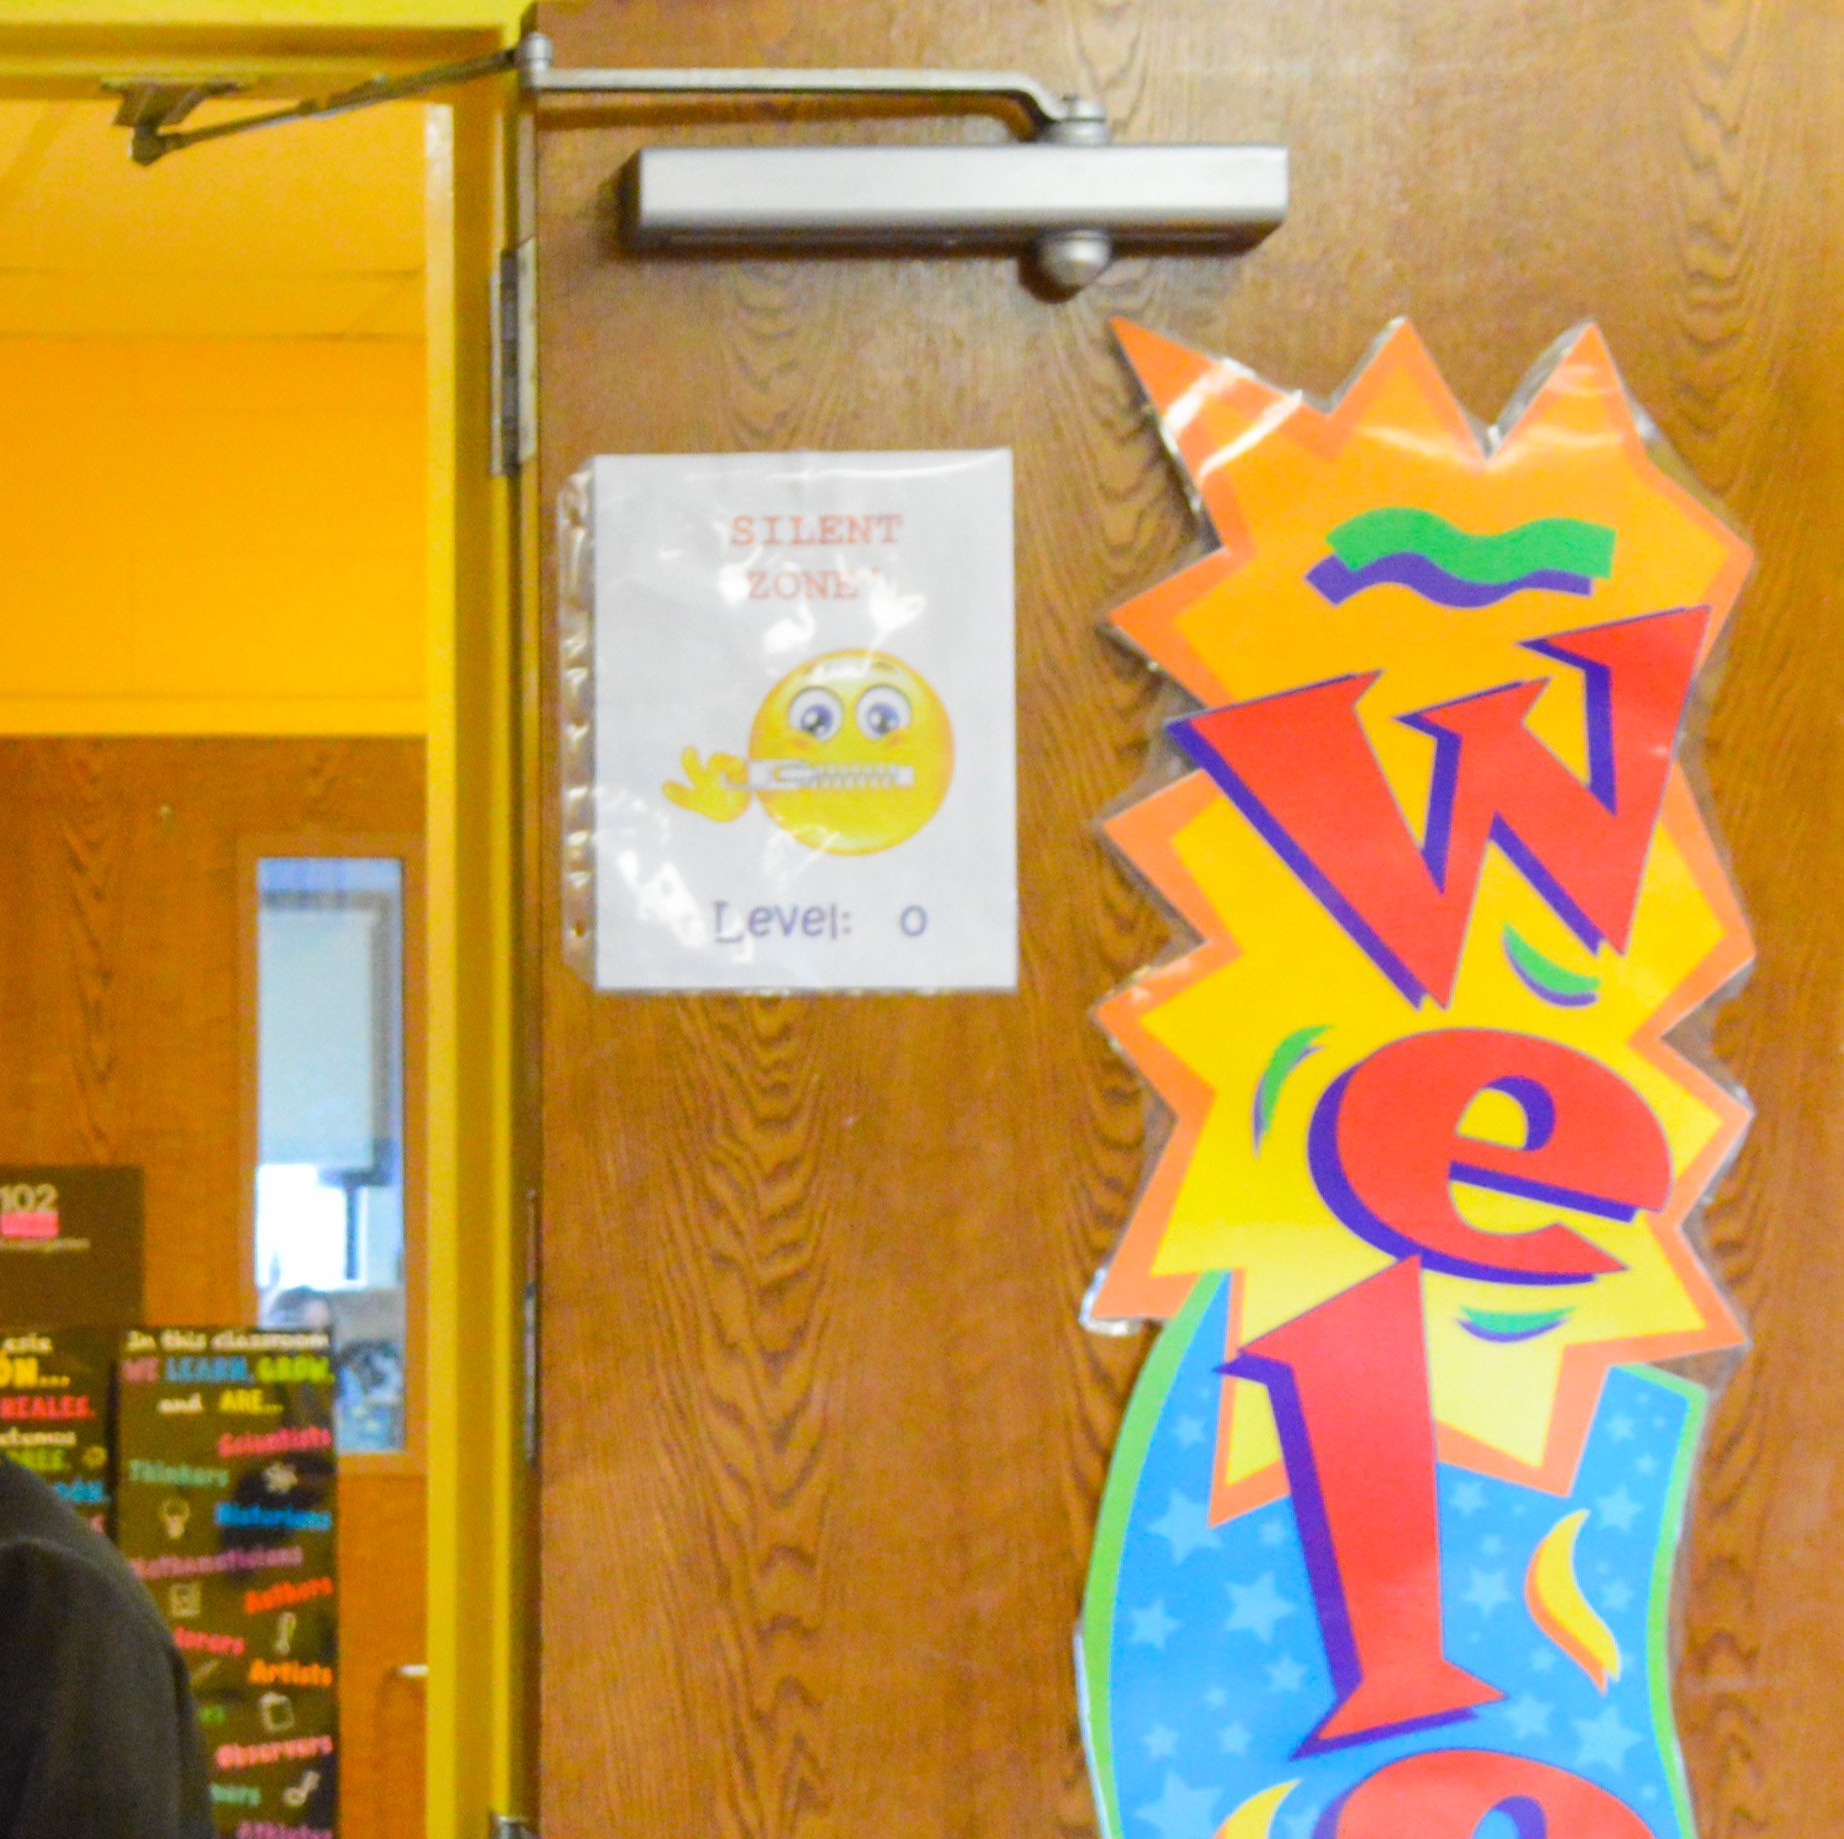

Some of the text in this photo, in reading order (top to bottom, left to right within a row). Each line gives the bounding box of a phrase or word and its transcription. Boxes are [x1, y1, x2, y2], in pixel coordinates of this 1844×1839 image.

[731, 514, 904, 546] SILENT
[714, 900, 852, 944] Level:
[127, 1329, 329, 1350] In this classroom
[121, 1357, 159, 1383] WE
[157, 1392, 202, 1414] and
[217, 1425, 333, 1458] Scientists
[129, 1458, 229, 1487] Thinkers
[216, 1502, 332, 1531] Historians
[244, 1576, 334, 1614] Authors
[248, 1658, 333, 1687] Artists
